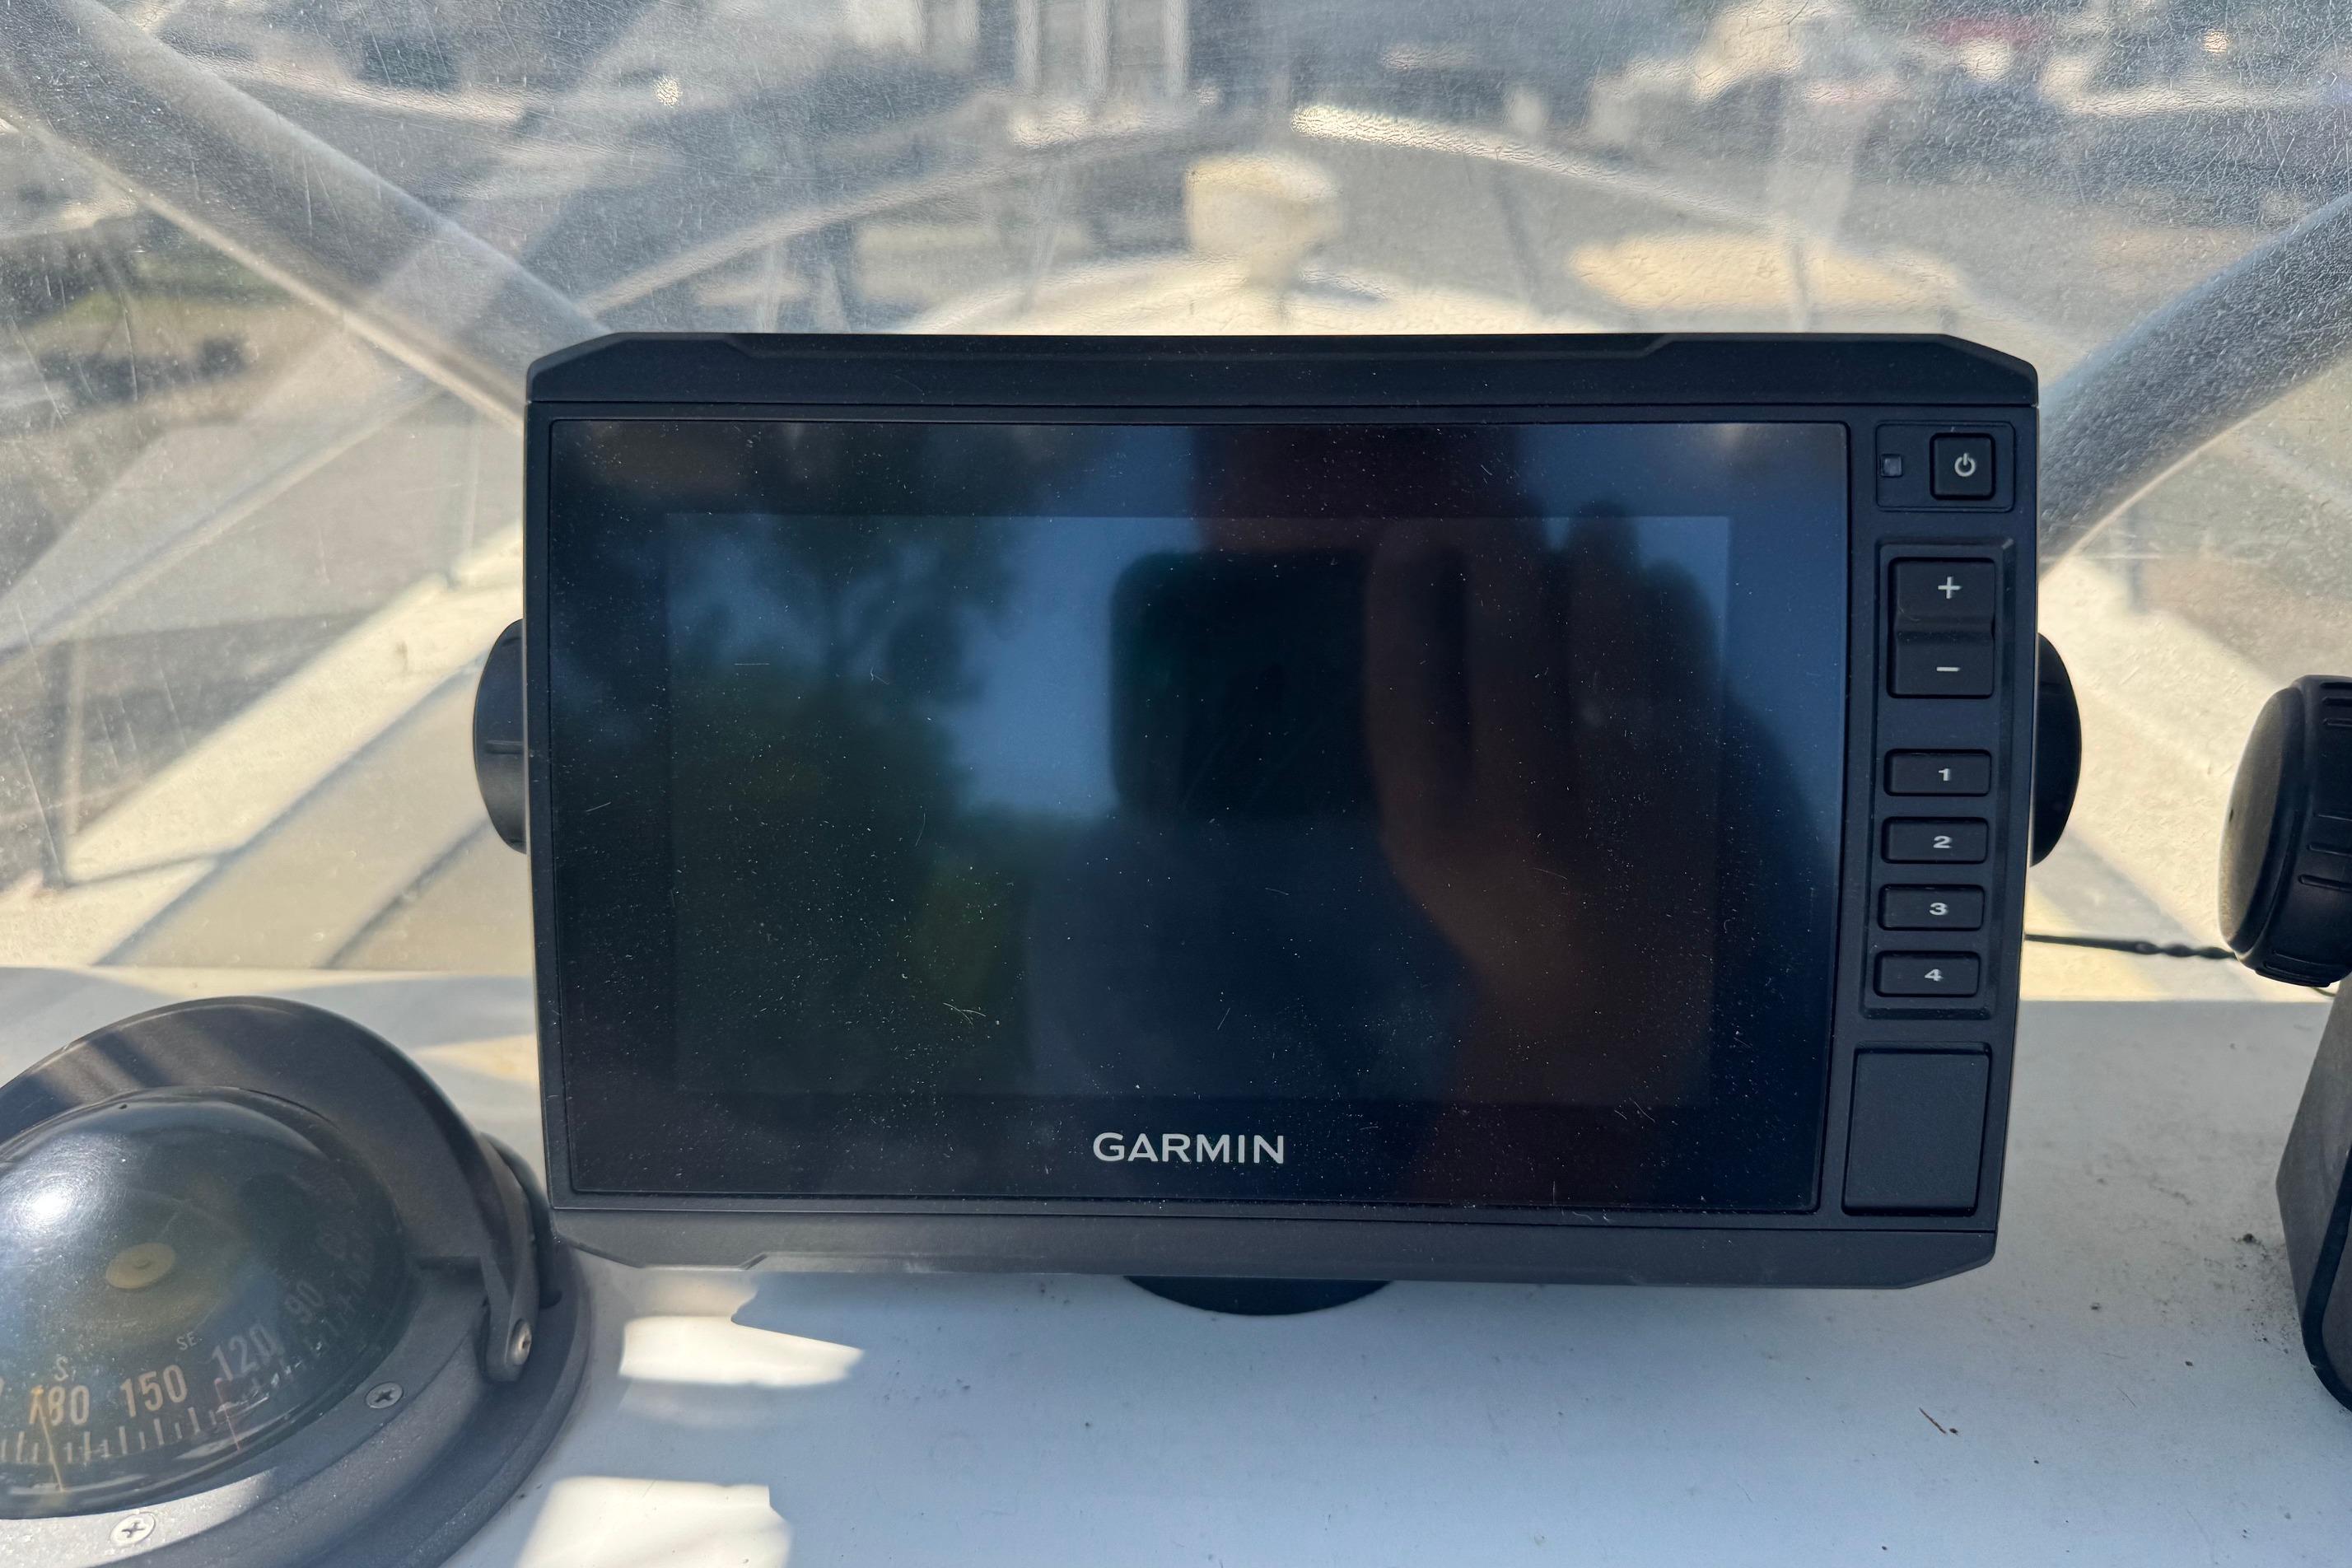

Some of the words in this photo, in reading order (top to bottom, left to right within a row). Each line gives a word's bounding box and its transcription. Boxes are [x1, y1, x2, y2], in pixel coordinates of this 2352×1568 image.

[1938, 768, 1951, 782] 1
[1933, 835, 1952, 849] 2
[1929, 903, 1948, 916] 3
[1924, 968, 1944, 982] 4
[1093, 1132, 1284, 1164] GARMIN
[176, 1331, 198, 1351] SE
[212, 1323, 282, 1383] 120
[54, 1356, 68, 1381] S
[119, 1365, 189, 1417] 150
[29, 1385, 90, 1426] 180
